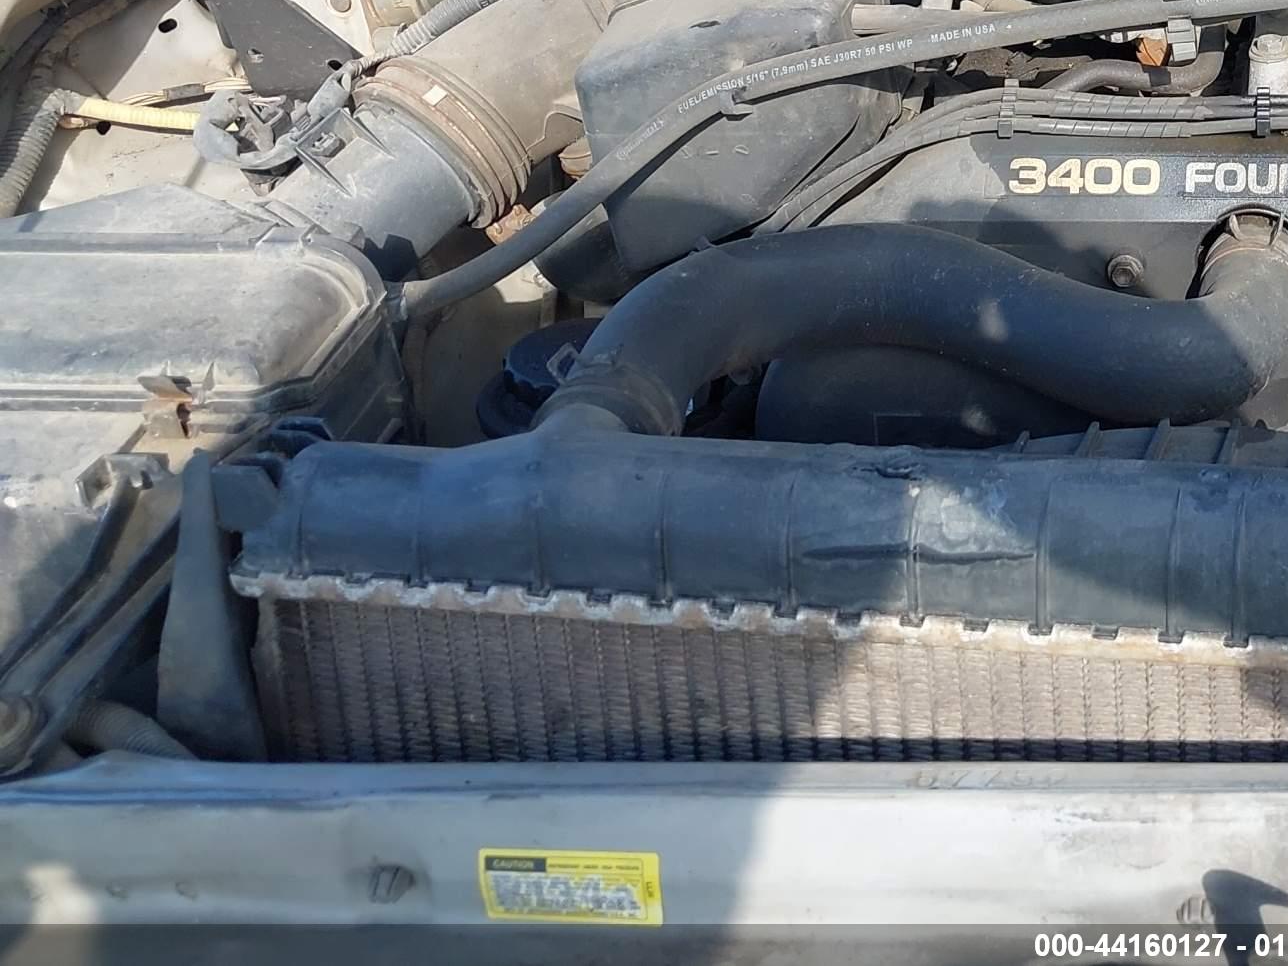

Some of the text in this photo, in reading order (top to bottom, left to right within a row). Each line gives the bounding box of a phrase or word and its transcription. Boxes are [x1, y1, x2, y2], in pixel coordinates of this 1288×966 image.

[678, 77, 744, 115] FUEL/EMISSION
[810, 54, 831, 68] SAE
[833, 50, 862, 63] J30R7
[865, 46, 876, 56] 50
[878, 43, 895, 55] PSI
[896, 39, 914, 51] WP
[930, 29, 960, 44] MADE
[962, 28, 972, 38] IN
[975, 23, 996, 35] USA
[1008, 158, 1160, 194] 3400
